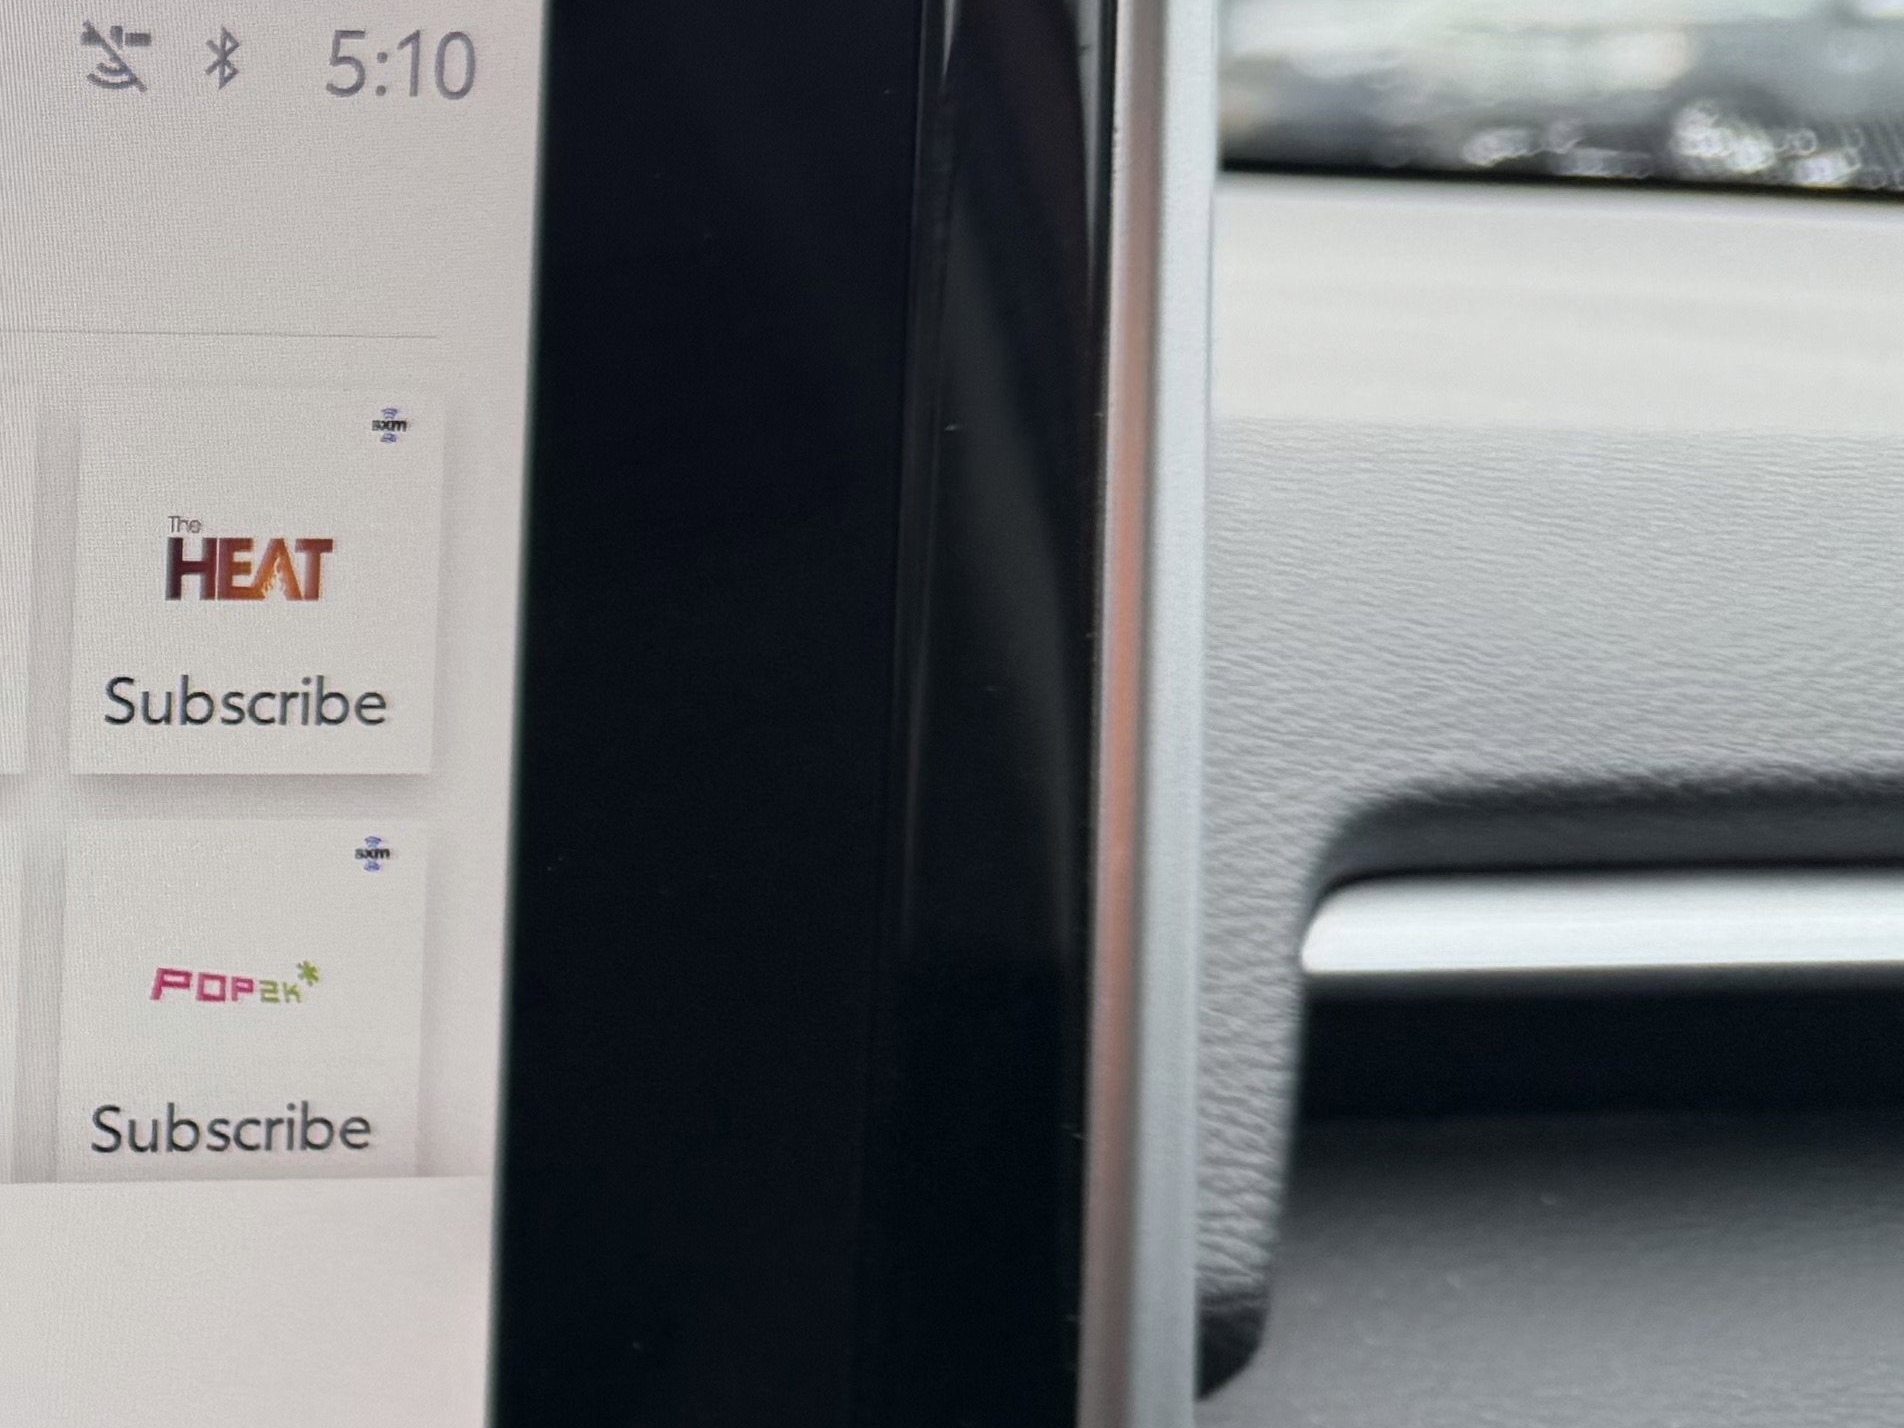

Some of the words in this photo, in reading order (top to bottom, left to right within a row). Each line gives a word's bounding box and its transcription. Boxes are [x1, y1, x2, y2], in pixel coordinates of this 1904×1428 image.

[324, 30, 478, 101] 5:10
[168, 516, 202, 534] The
[165, 537, 334, 601] HEAT
[103, 675, 388, 729] Subscribe
[90, 1101, 372, 1155] Subscribe
